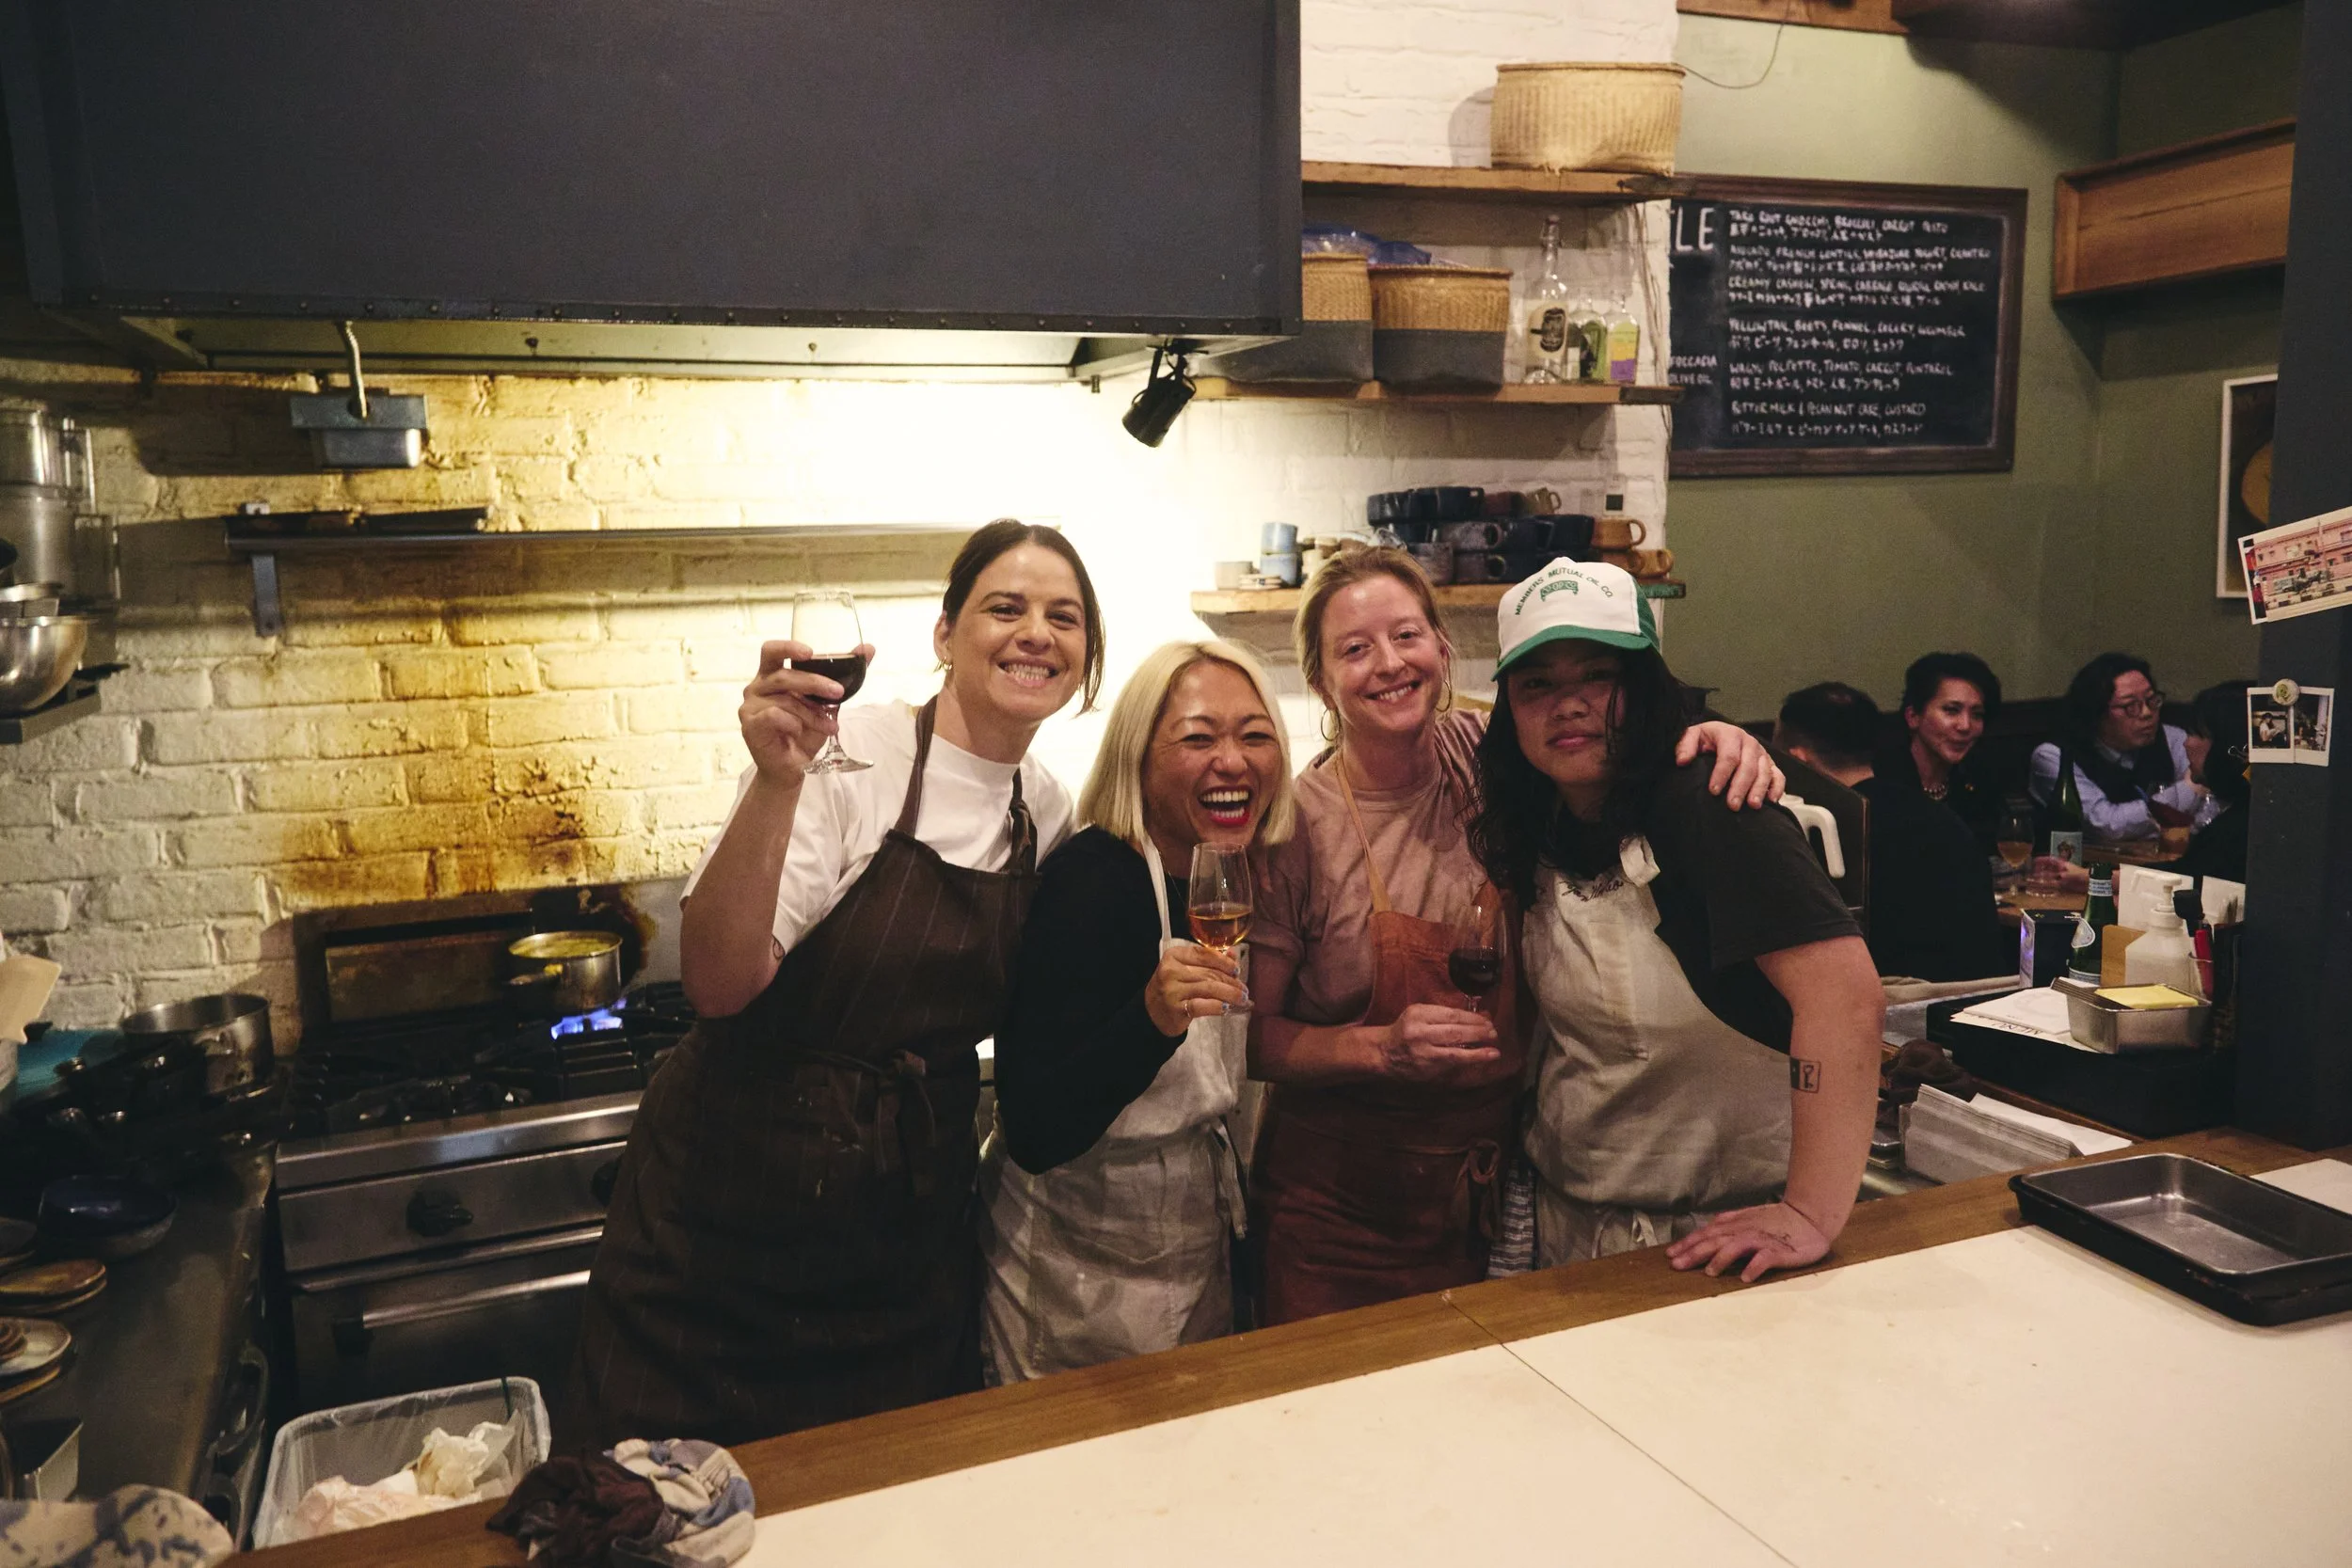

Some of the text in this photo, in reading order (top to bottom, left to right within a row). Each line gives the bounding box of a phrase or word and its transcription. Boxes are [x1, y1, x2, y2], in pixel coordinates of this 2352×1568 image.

[1670, 206, 1715, 251] LE
[1515, 566, 1613, 616] MEMBERS MUTUAL OIL CO
